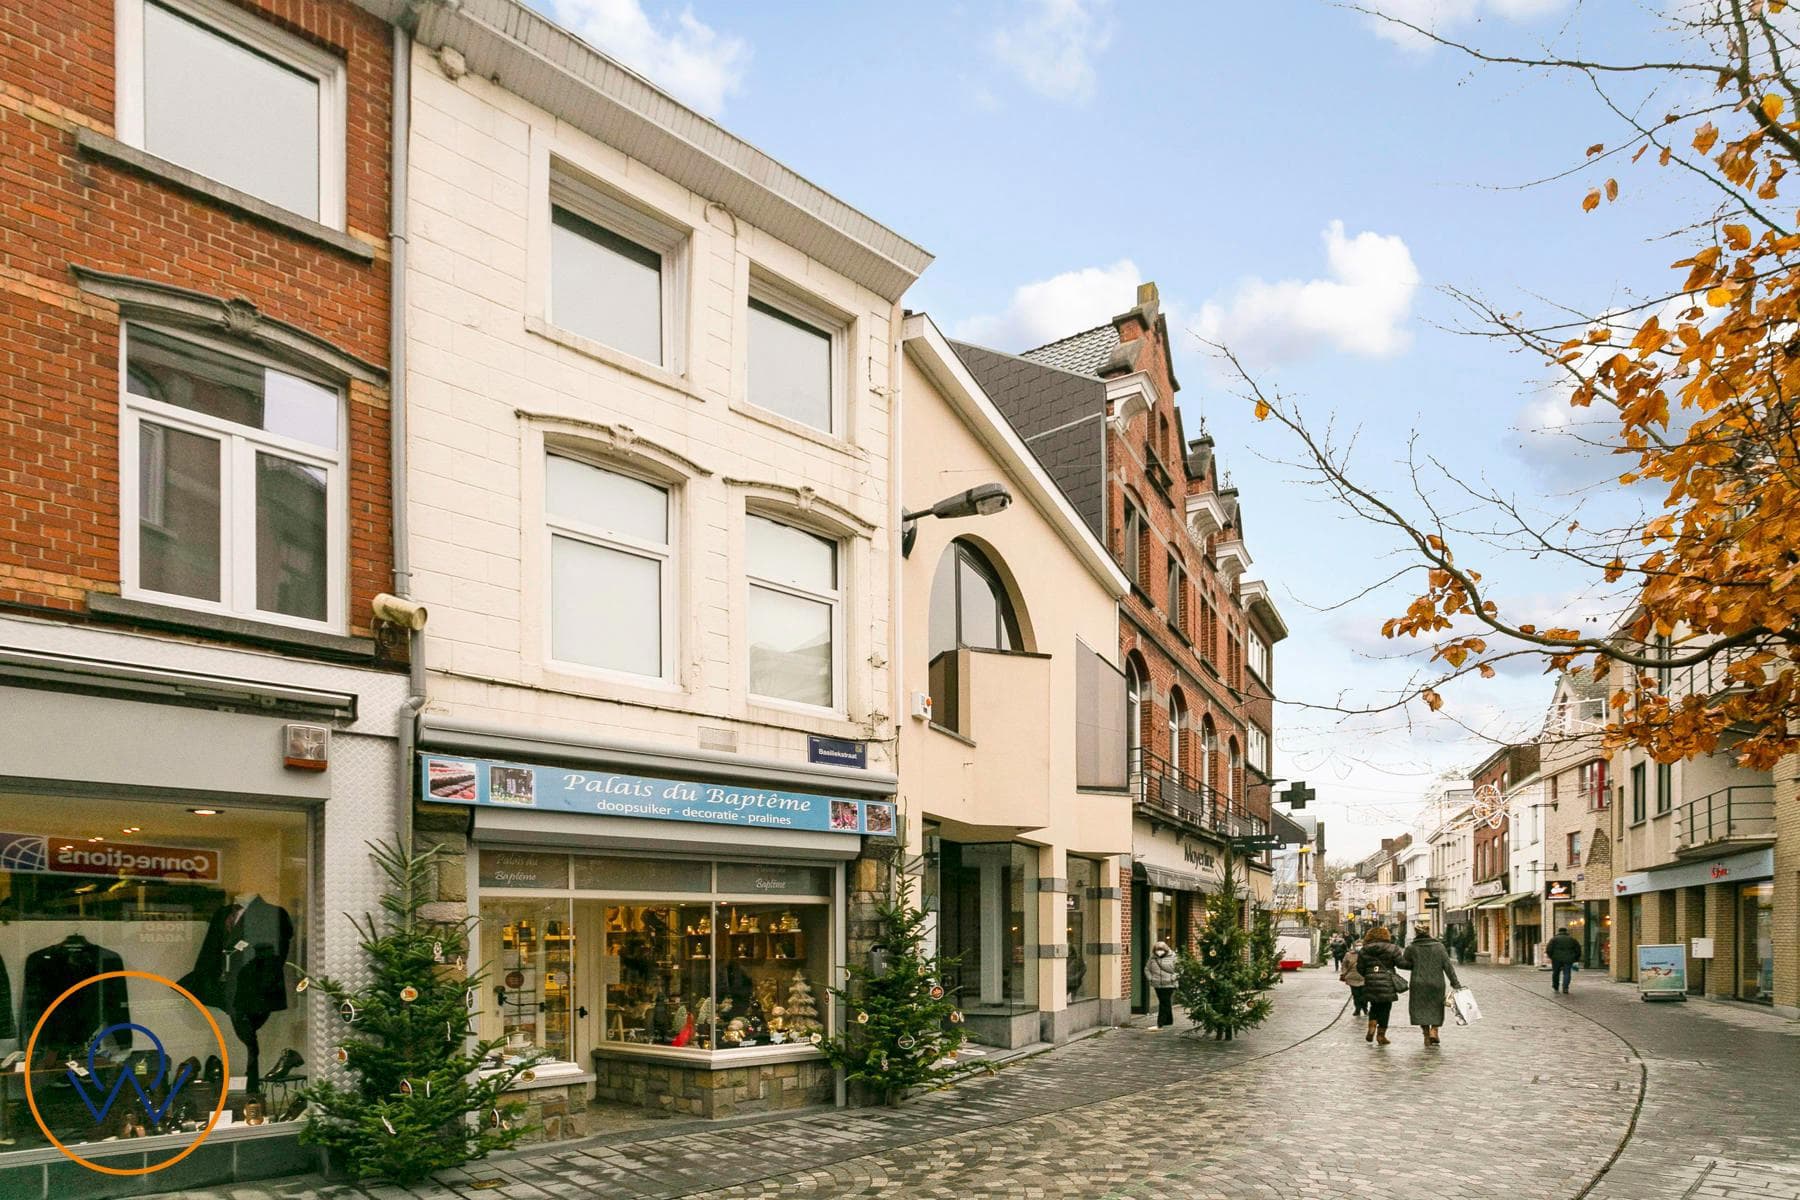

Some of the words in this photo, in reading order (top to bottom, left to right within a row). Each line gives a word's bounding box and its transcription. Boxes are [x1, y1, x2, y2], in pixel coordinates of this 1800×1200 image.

[563, 774, 653, 797] Palais
[662, 783, 697, 801] du
[706, 788, 811, 812] Baptême
[597, 799, 672, 815] doopsuiker
[682, 807, 738, 821] decoratie
[748, 812, 791, 825] pralines
